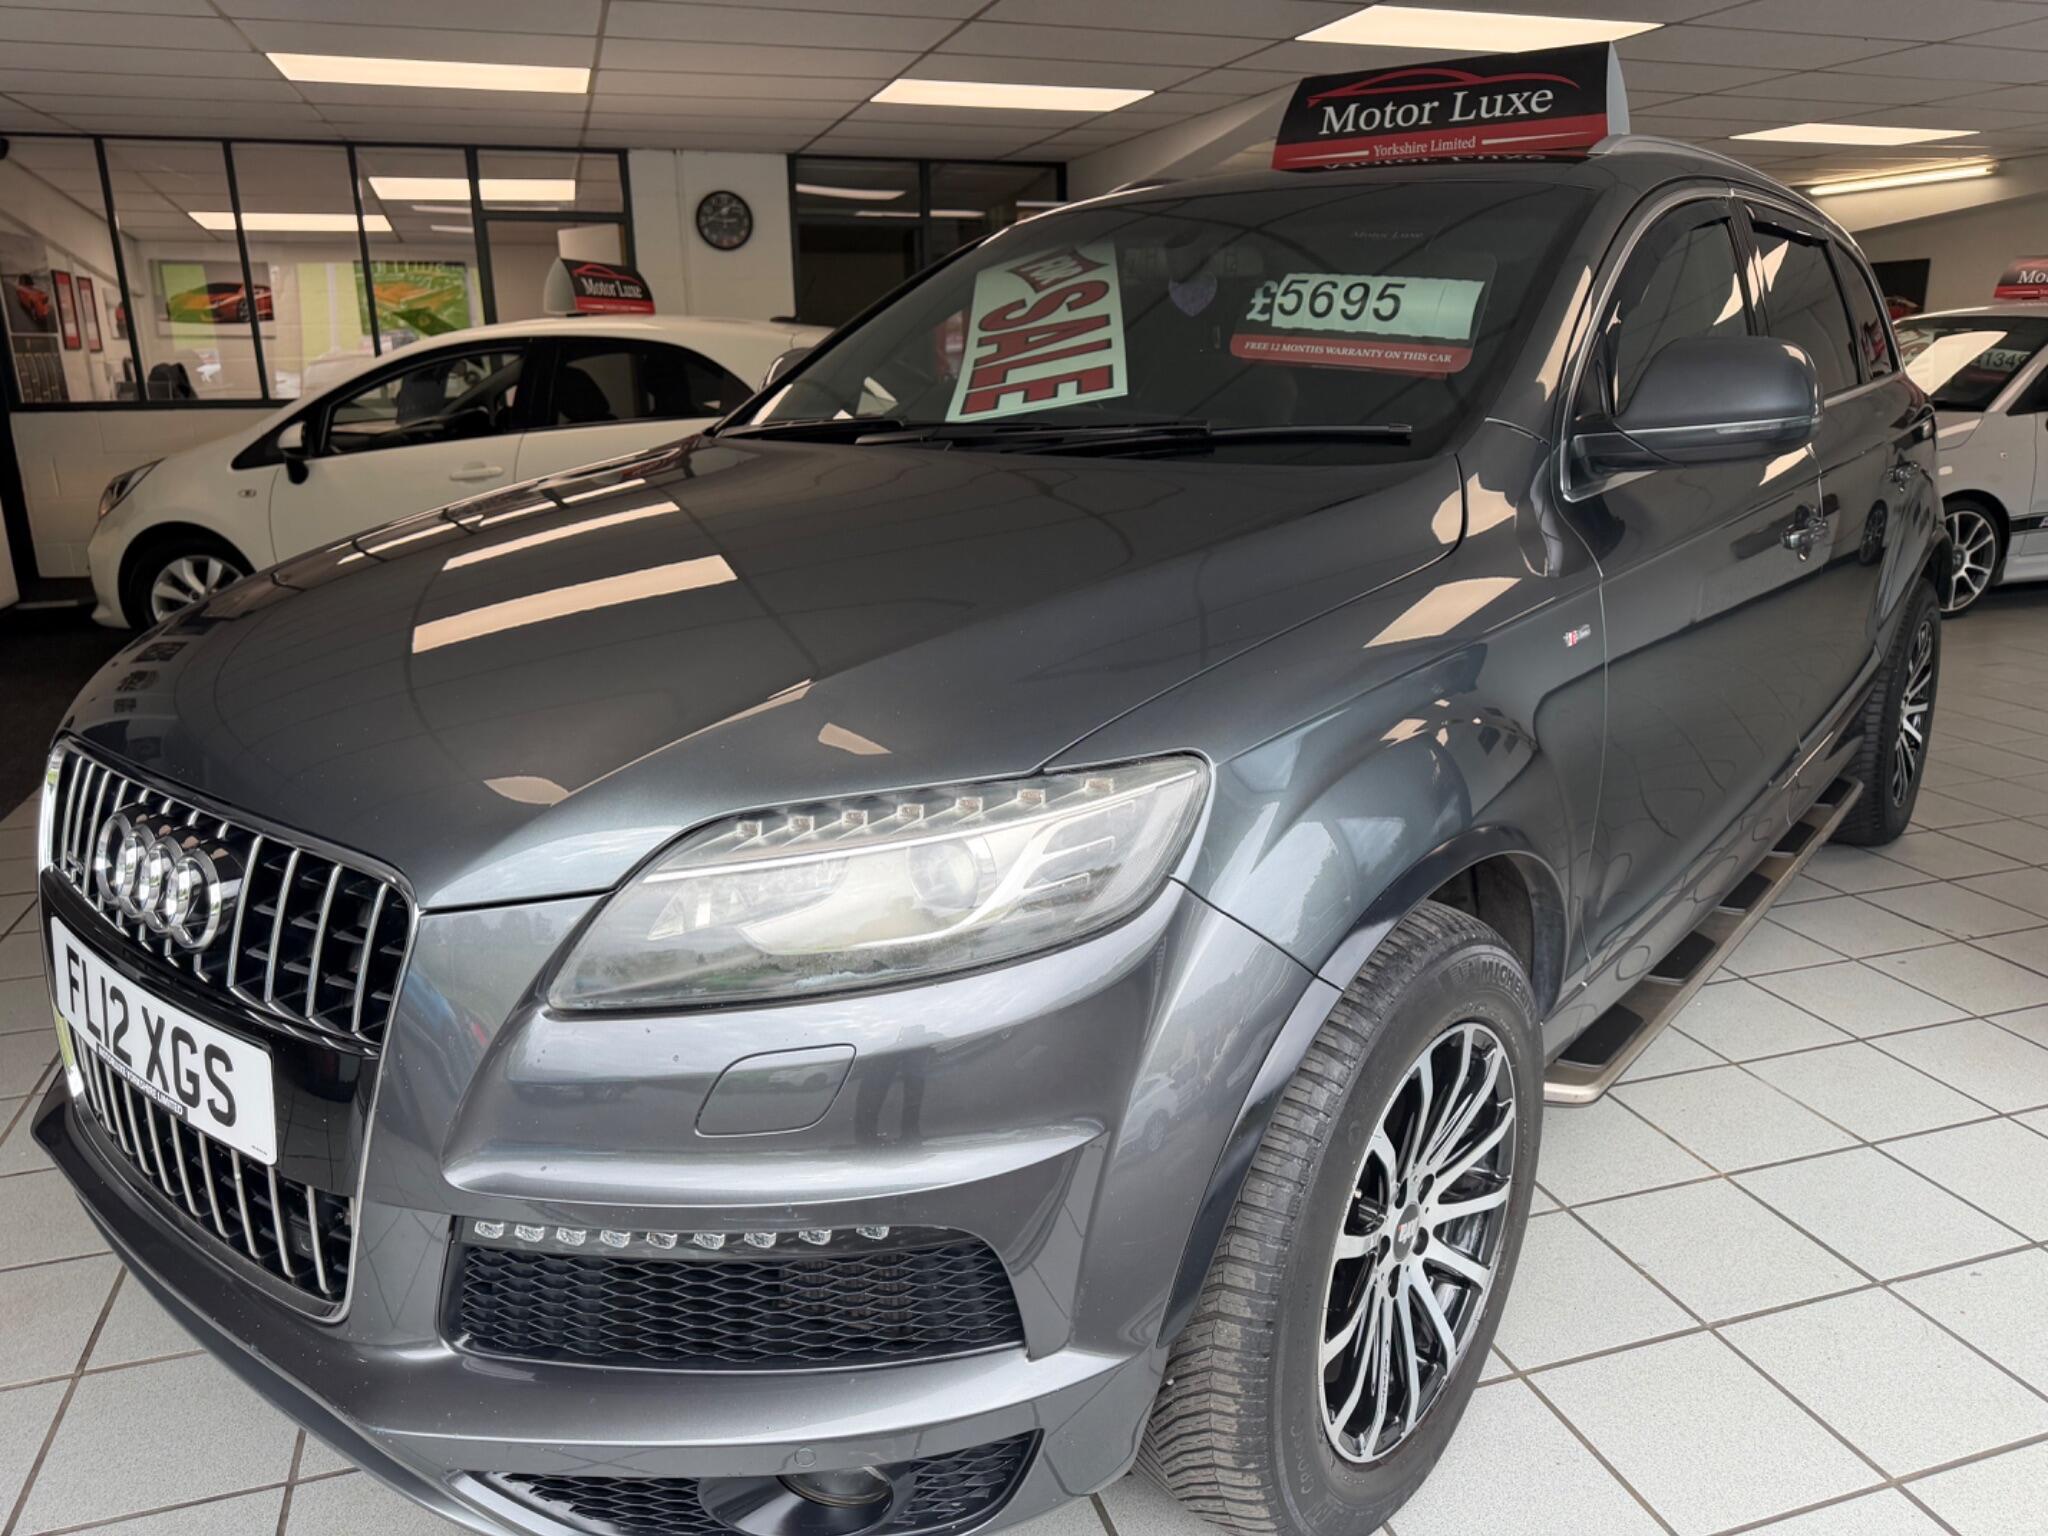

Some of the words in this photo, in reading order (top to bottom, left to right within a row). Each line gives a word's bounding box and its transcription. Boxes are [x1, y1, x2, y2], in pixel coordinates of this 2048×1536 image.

[1318, 100, 1440, 136] Motor
[1448, 88, 1555, 123] Luxe
[1373, 142, 1428, 158] Yorkshire
[1431, 135, 1477, 153] Limited
[2016, 269, 2048, 284] Mo
[1245, 279, 1407, 323] £5695
[960, 279, 1114, 416] SALE
[1244, 341, 1269, 352] FREE
[1270, 342, 1280, 352] 12
[1281, 343, 1325, 355] MONTHS
[1326, 345, 1385, 359] WARRANTY
[1384, 350, 1401, 360] ON
[1401, 350, 1428, 362] THIS
[1428, 352, 1453, 363] CAR
[66, 943, 133, 1071] FL12
[141, 1005, 237, 1128] XGS
